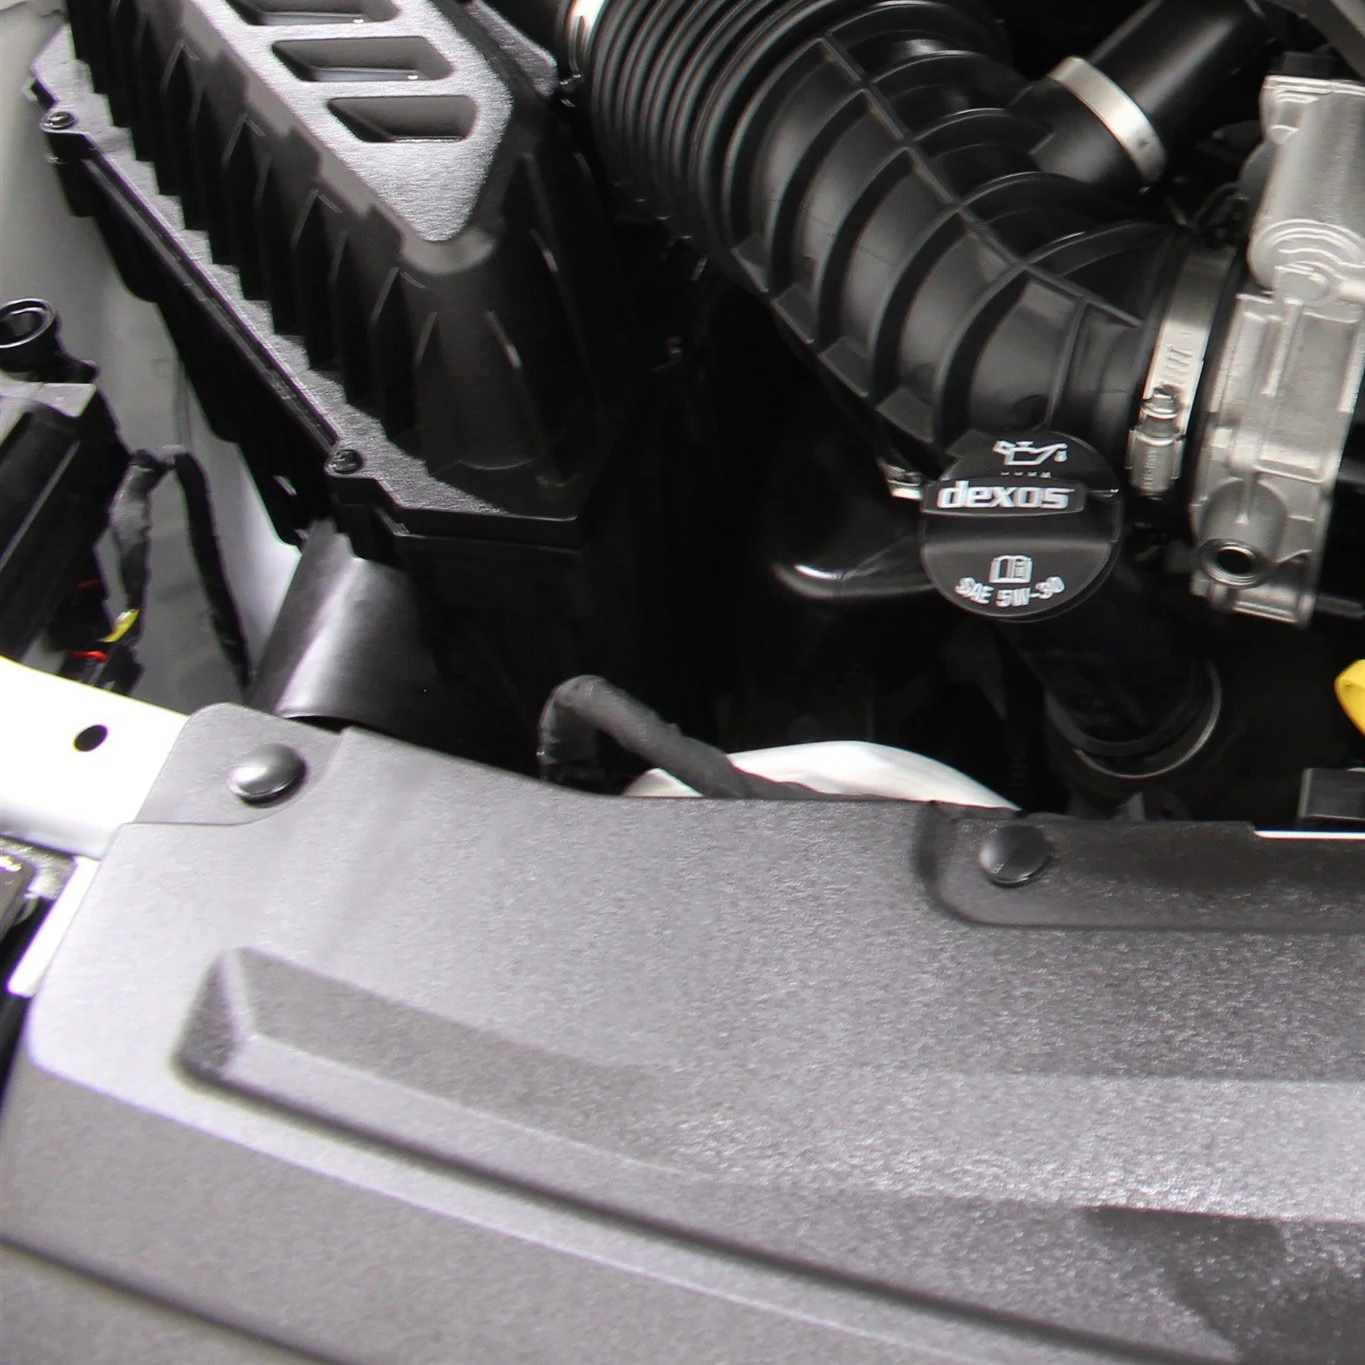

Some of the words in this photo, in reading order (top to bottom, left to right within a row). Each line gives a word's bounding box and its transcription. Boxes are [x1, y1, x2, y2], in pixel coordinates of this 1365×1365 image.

[936, 480, 1075, 510] dexos
[955, 577, 994, 604] SAE
[996, 576, 1066, 608] 5W-30
